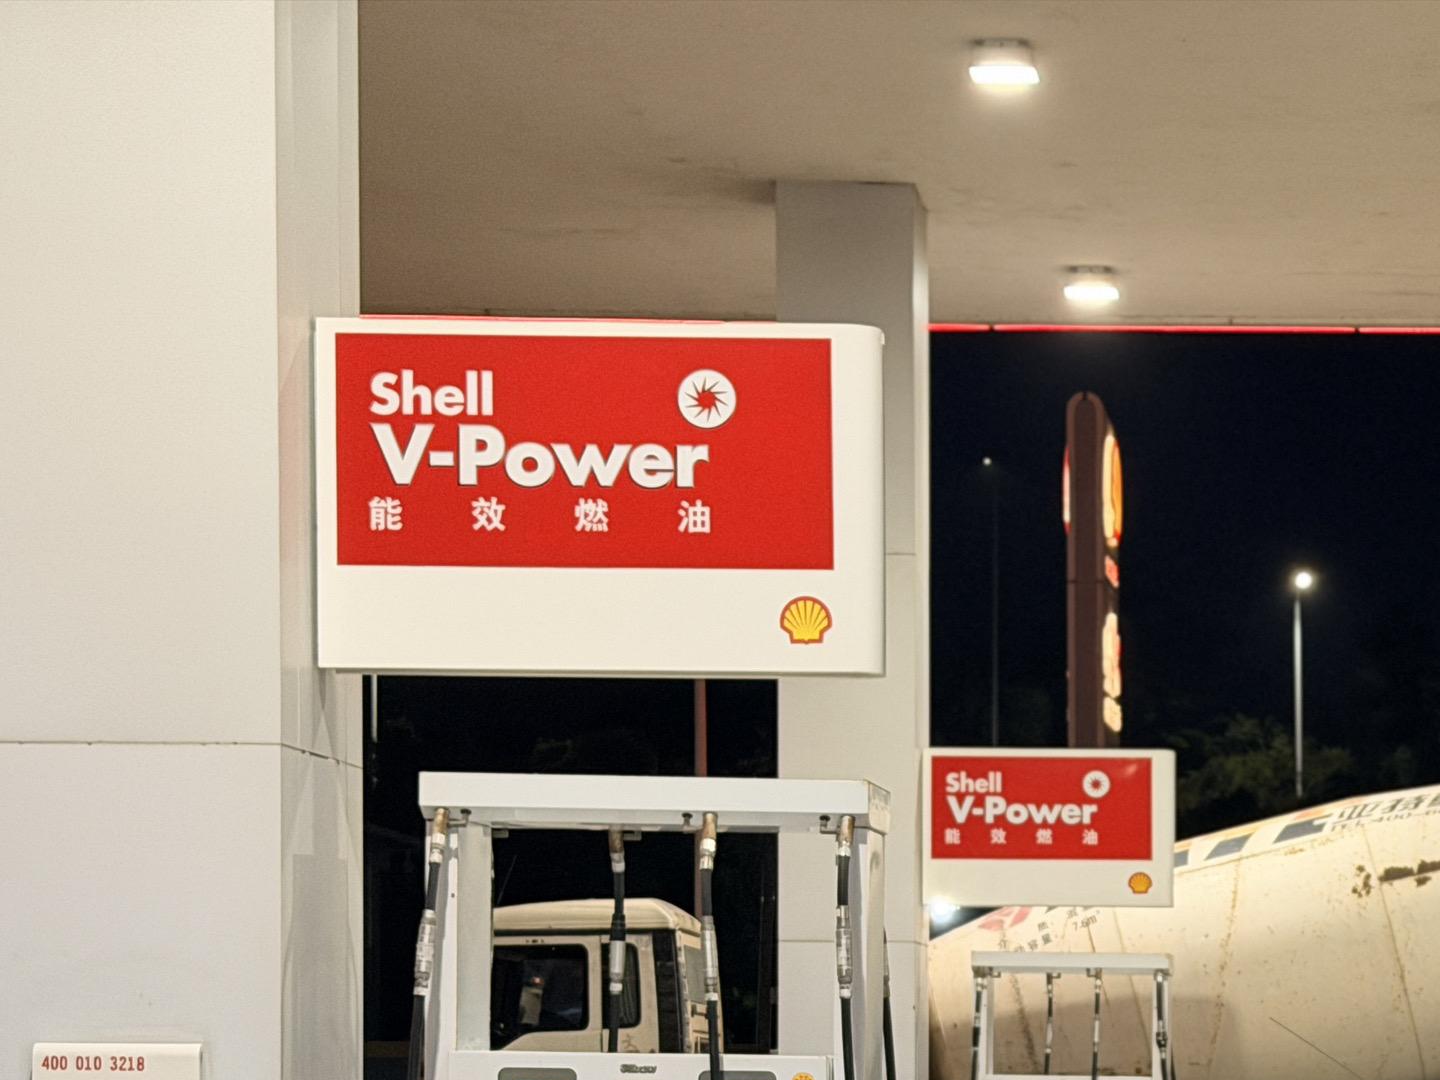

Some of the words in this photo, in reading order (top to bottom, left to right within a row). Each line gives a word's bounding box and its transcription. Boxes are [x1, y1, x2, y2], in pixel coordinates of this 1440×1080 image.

[369, 369, 494, 417] Shell
[369, 422, 710, 488] V-Power
[368, 497, 711, 534] 能效燃油
[945, 771, 1002, 794] Shell
[946, 795, 1098, 825] V-Power
[944, 828, 1099, 846] 能效燃油
[41, 1056, 68, 1071] 400
[76, 1056, 102, 1071] 010
[110, 1056, 145, 1072] 3218
